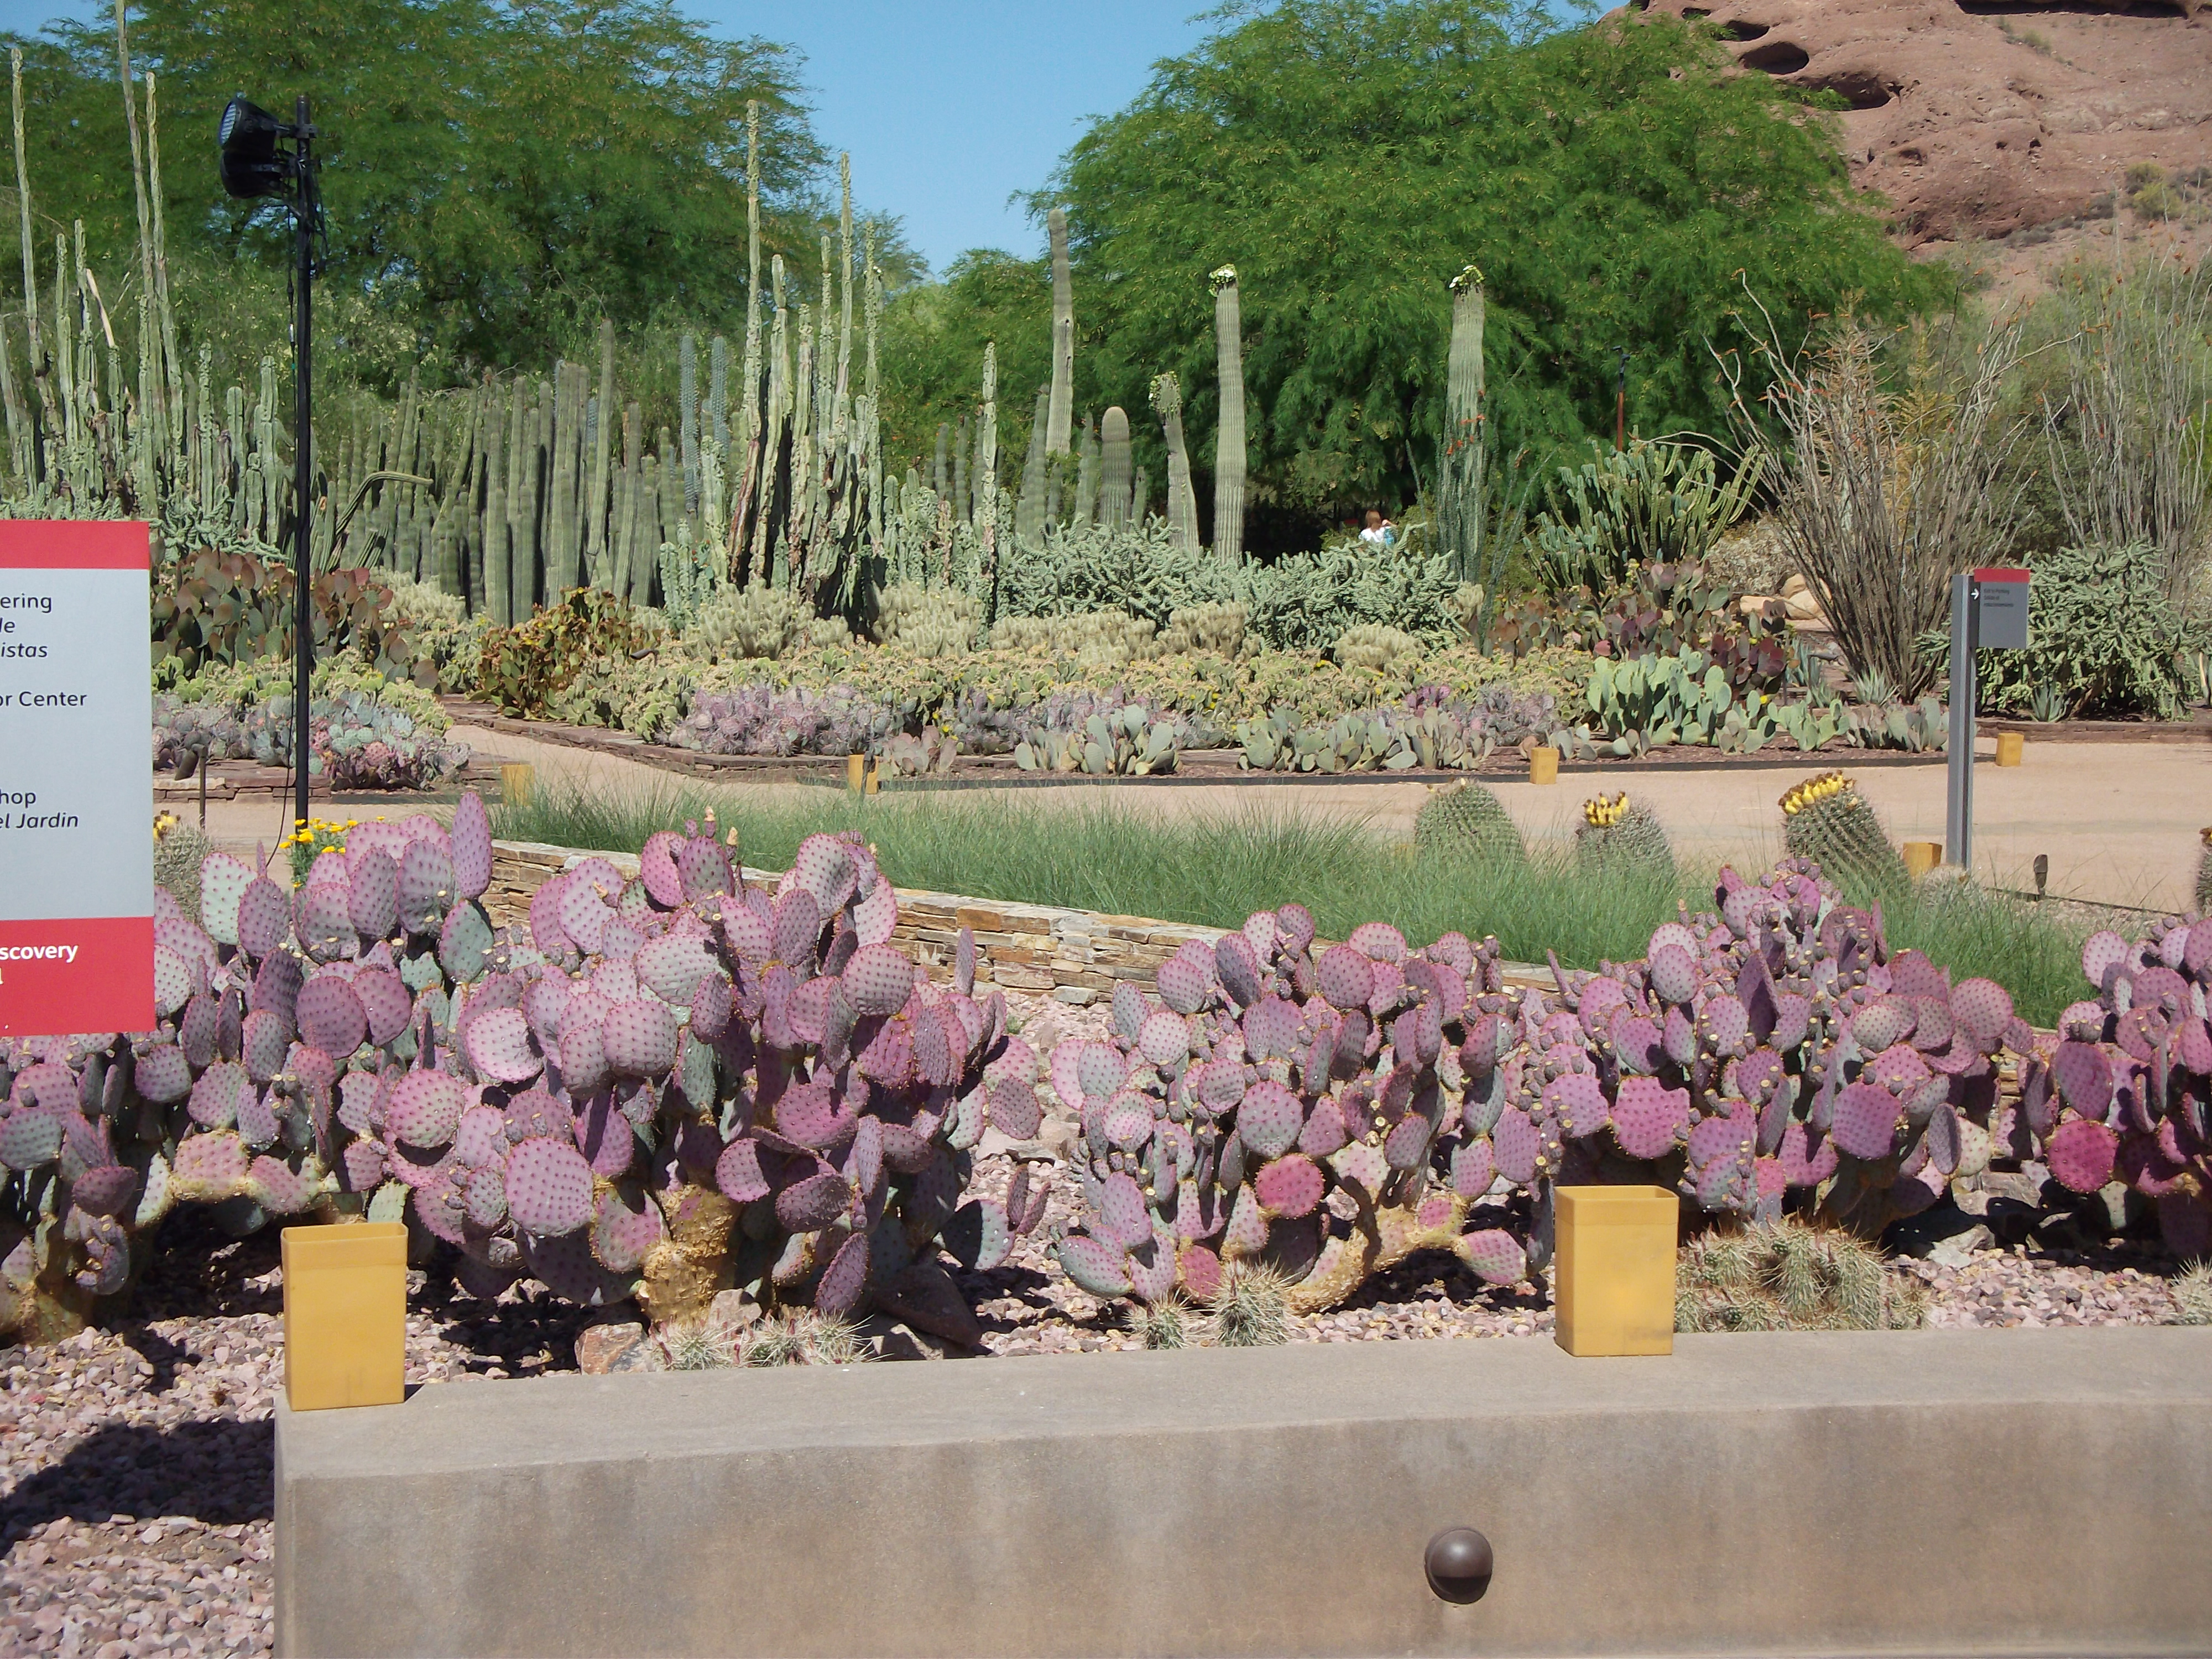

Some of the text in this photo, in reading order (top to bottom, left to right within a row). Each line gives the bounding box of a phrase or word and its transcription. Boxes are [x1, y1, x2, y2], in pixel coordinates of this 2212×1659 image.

[0, 593, 52, 613] ering
[1, 642, 48, 658] istas
[18, 691, 87, 706] Center
[0, 788, 36, 808] hop
[15, 811, 78, 828] Jardin
[0, 945, 79, 963] scovery
